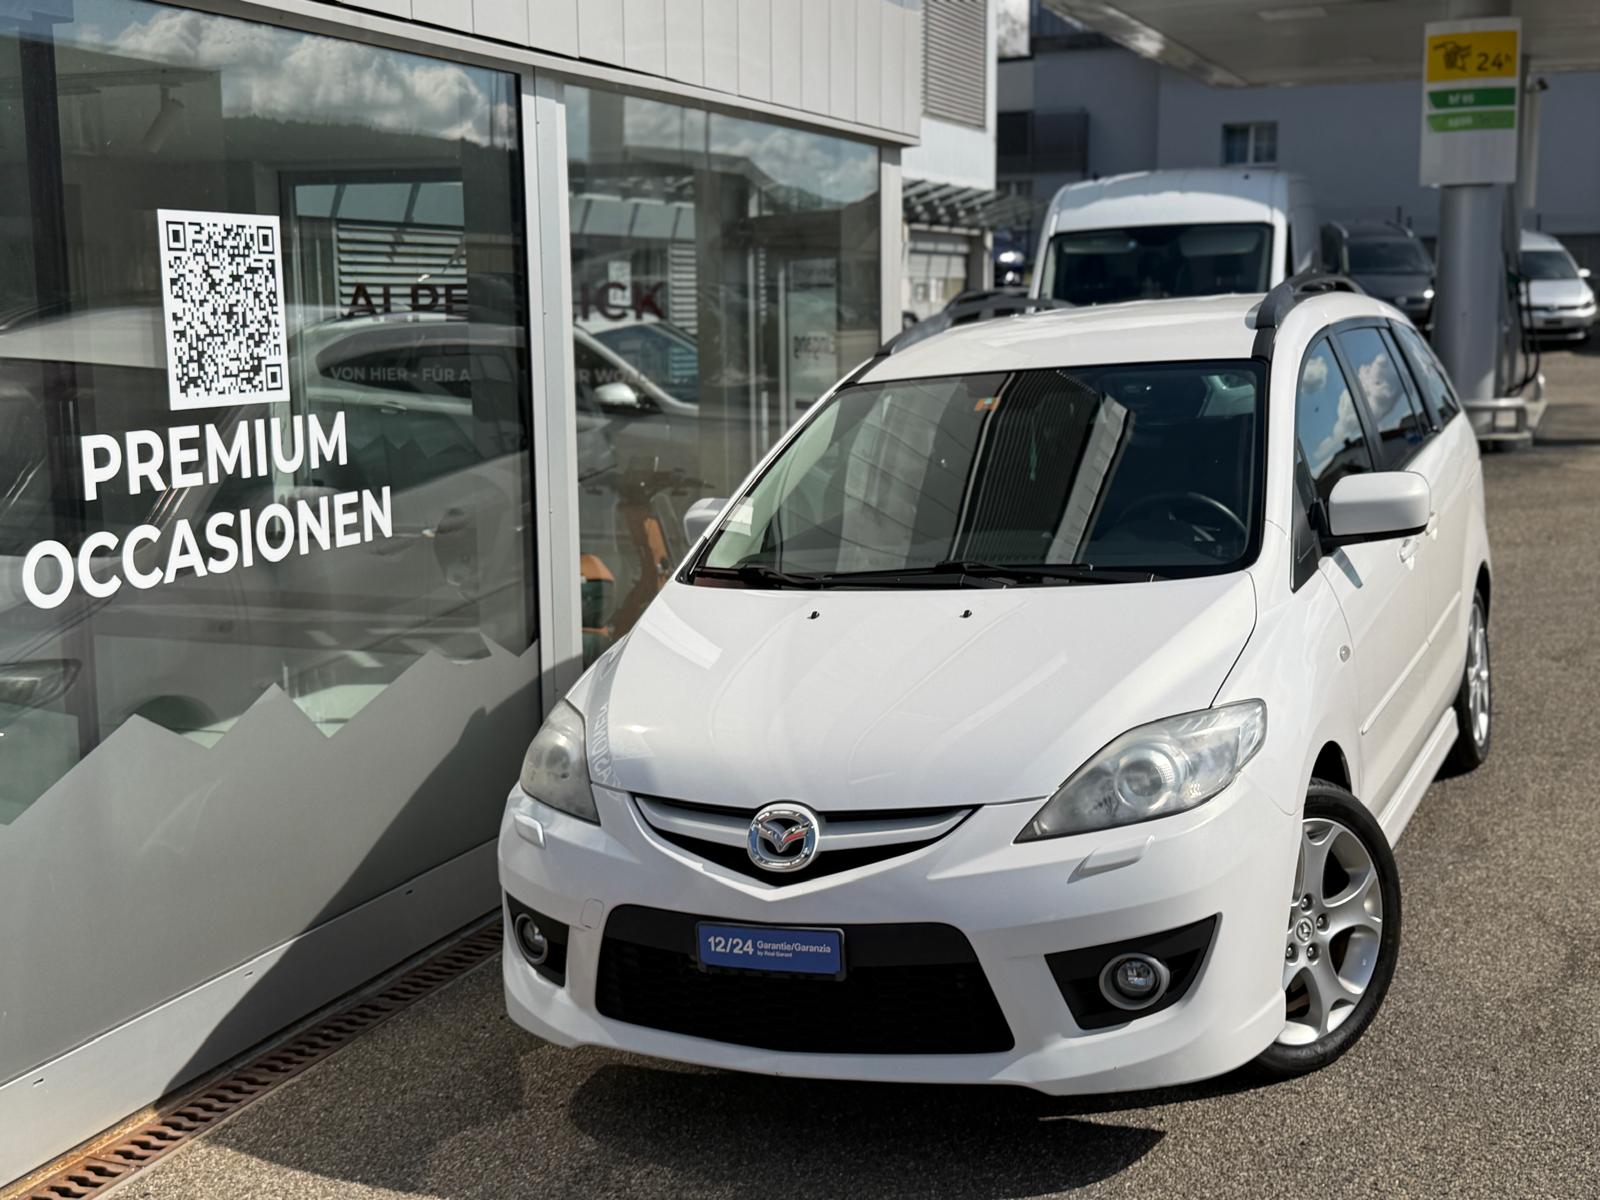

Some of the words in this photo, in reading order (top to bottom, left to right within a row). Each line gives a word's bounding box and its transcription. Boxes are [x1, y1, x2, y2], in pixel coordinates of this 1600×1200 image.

[575, 282, 666, 321] ICK
[329, 366, 366, 381] VON
[369, 366, 408, 381] HIER
[422, 364, 455, 382] FÜR
[80, 411, 348, 501] PREMIUM
[22, 485, 393, 609] OCCASIONEN
[707, 936, 754, 955] 12/24
[756, 940, 832, 954] Garantie/Garanzia
